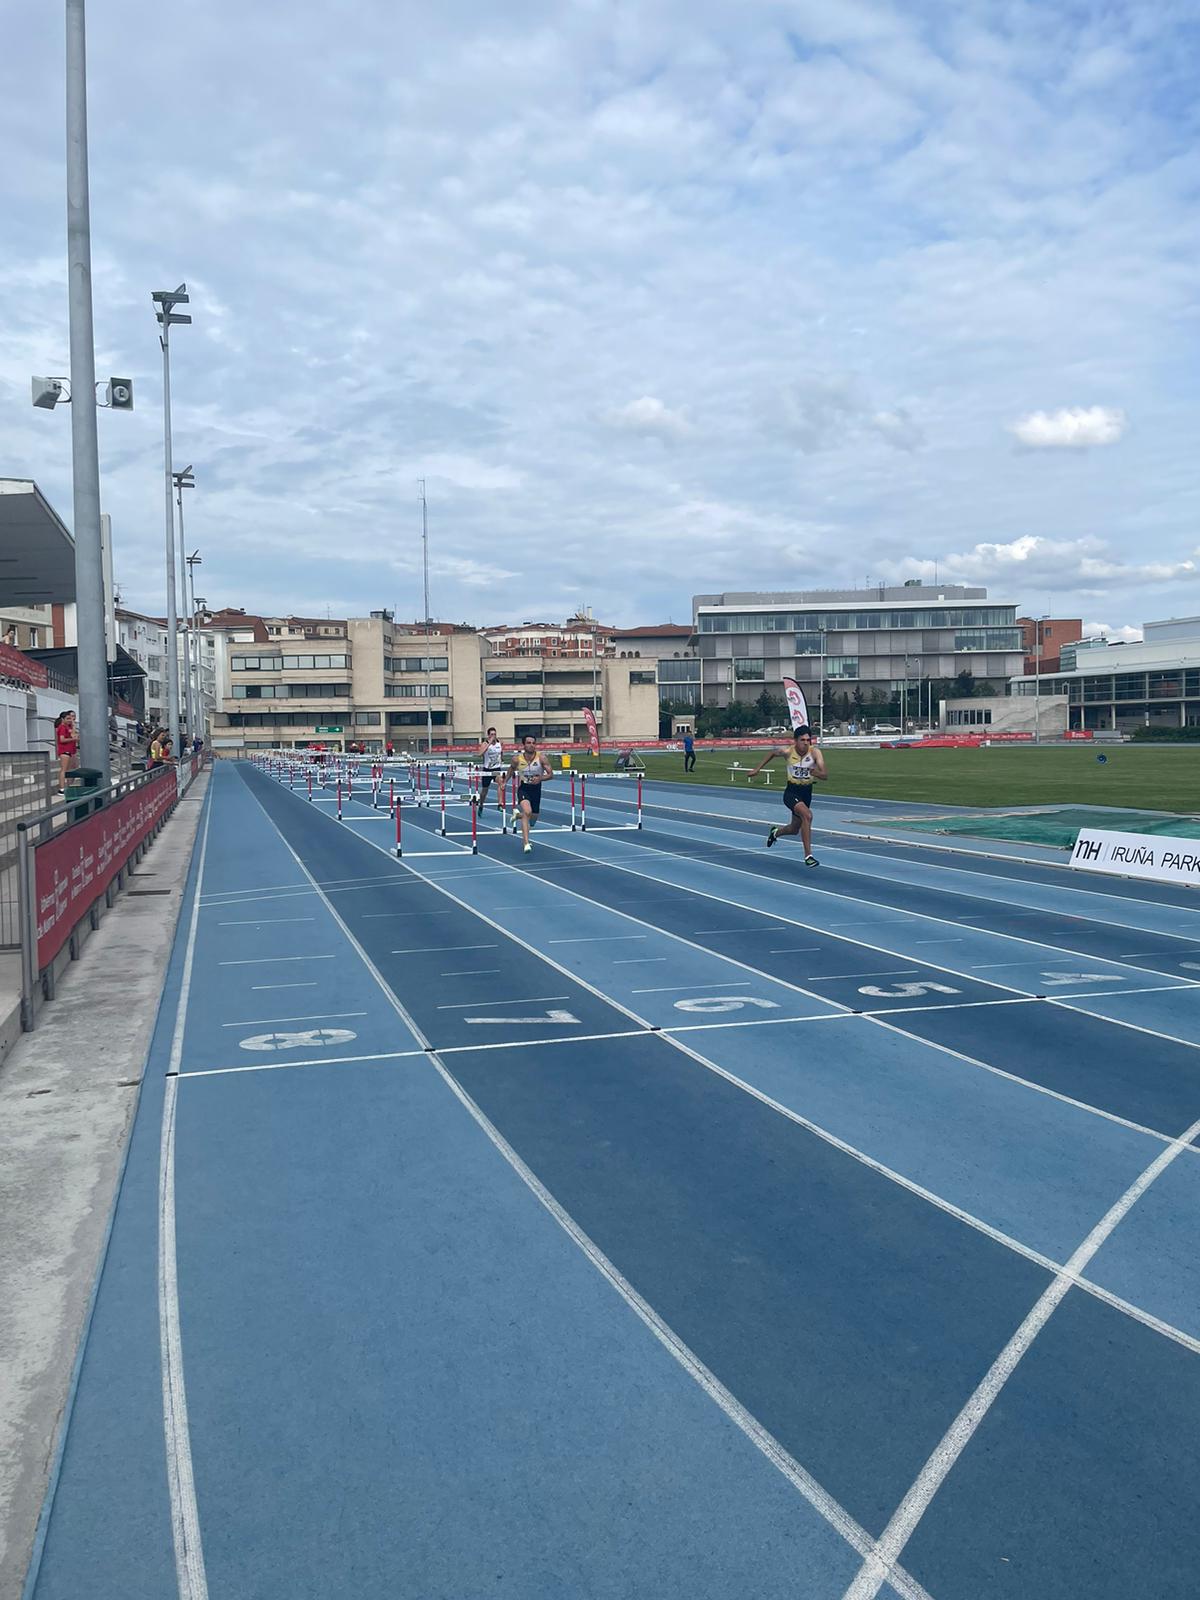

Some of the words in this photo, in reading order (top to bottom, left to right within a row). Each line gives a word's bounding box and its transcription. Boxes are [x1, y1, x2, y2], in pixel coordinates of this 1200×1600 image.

[1110, 846, 1154, 866] IRUÑA
[1160, 852, 1200, 872] PARK
[857, 981, 963, 997] 5
[673, 996, 783, 1013] 6
[239, 1028, 358, 1051] 8
